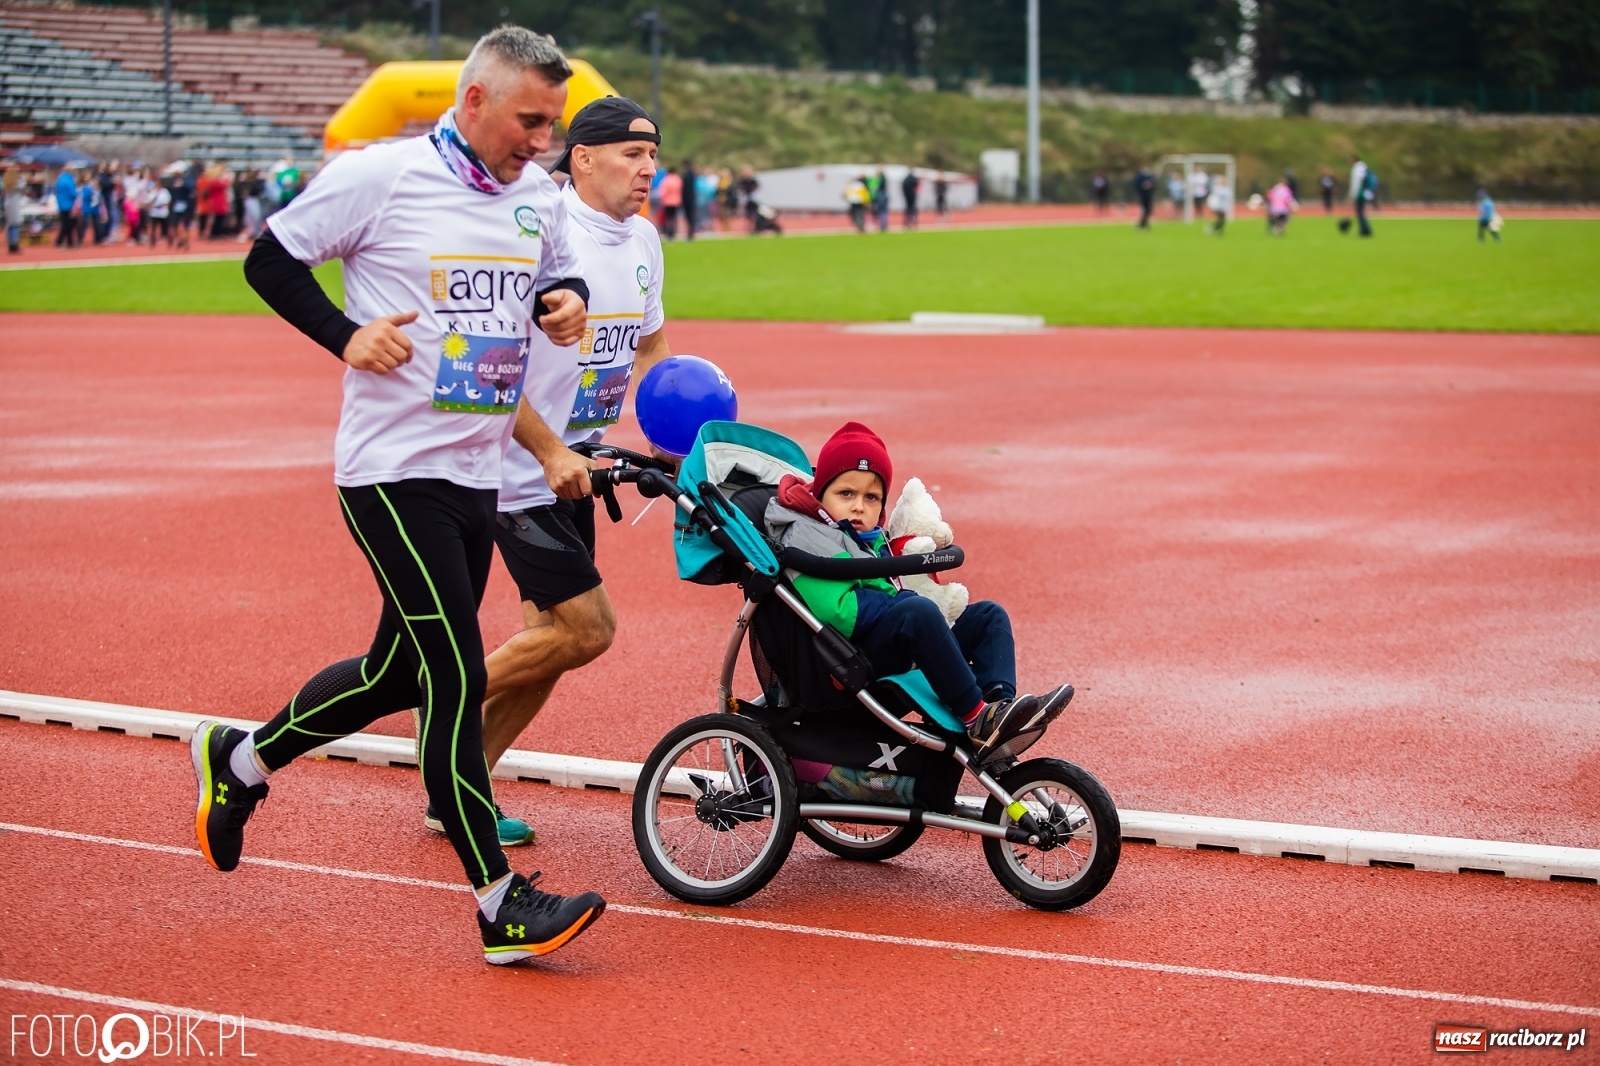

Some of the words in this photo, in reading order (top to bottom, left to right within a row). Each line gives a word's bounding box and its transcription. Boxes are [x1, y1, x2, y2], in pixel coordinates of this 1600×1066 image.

[432, 270, 446, 300] HBU
[449, 269, 532, 314] agro
[580, 328, 593, 353] HBU
[452, 360, 474, 373] BIEG
[477, 363, 495, 374] DLA
[494, 389, 517, 405] 142
[584, 389, 598, 398] BIEG
[603, 405, 619, 419] 135
[921, 553, 956, 565] X-lander
